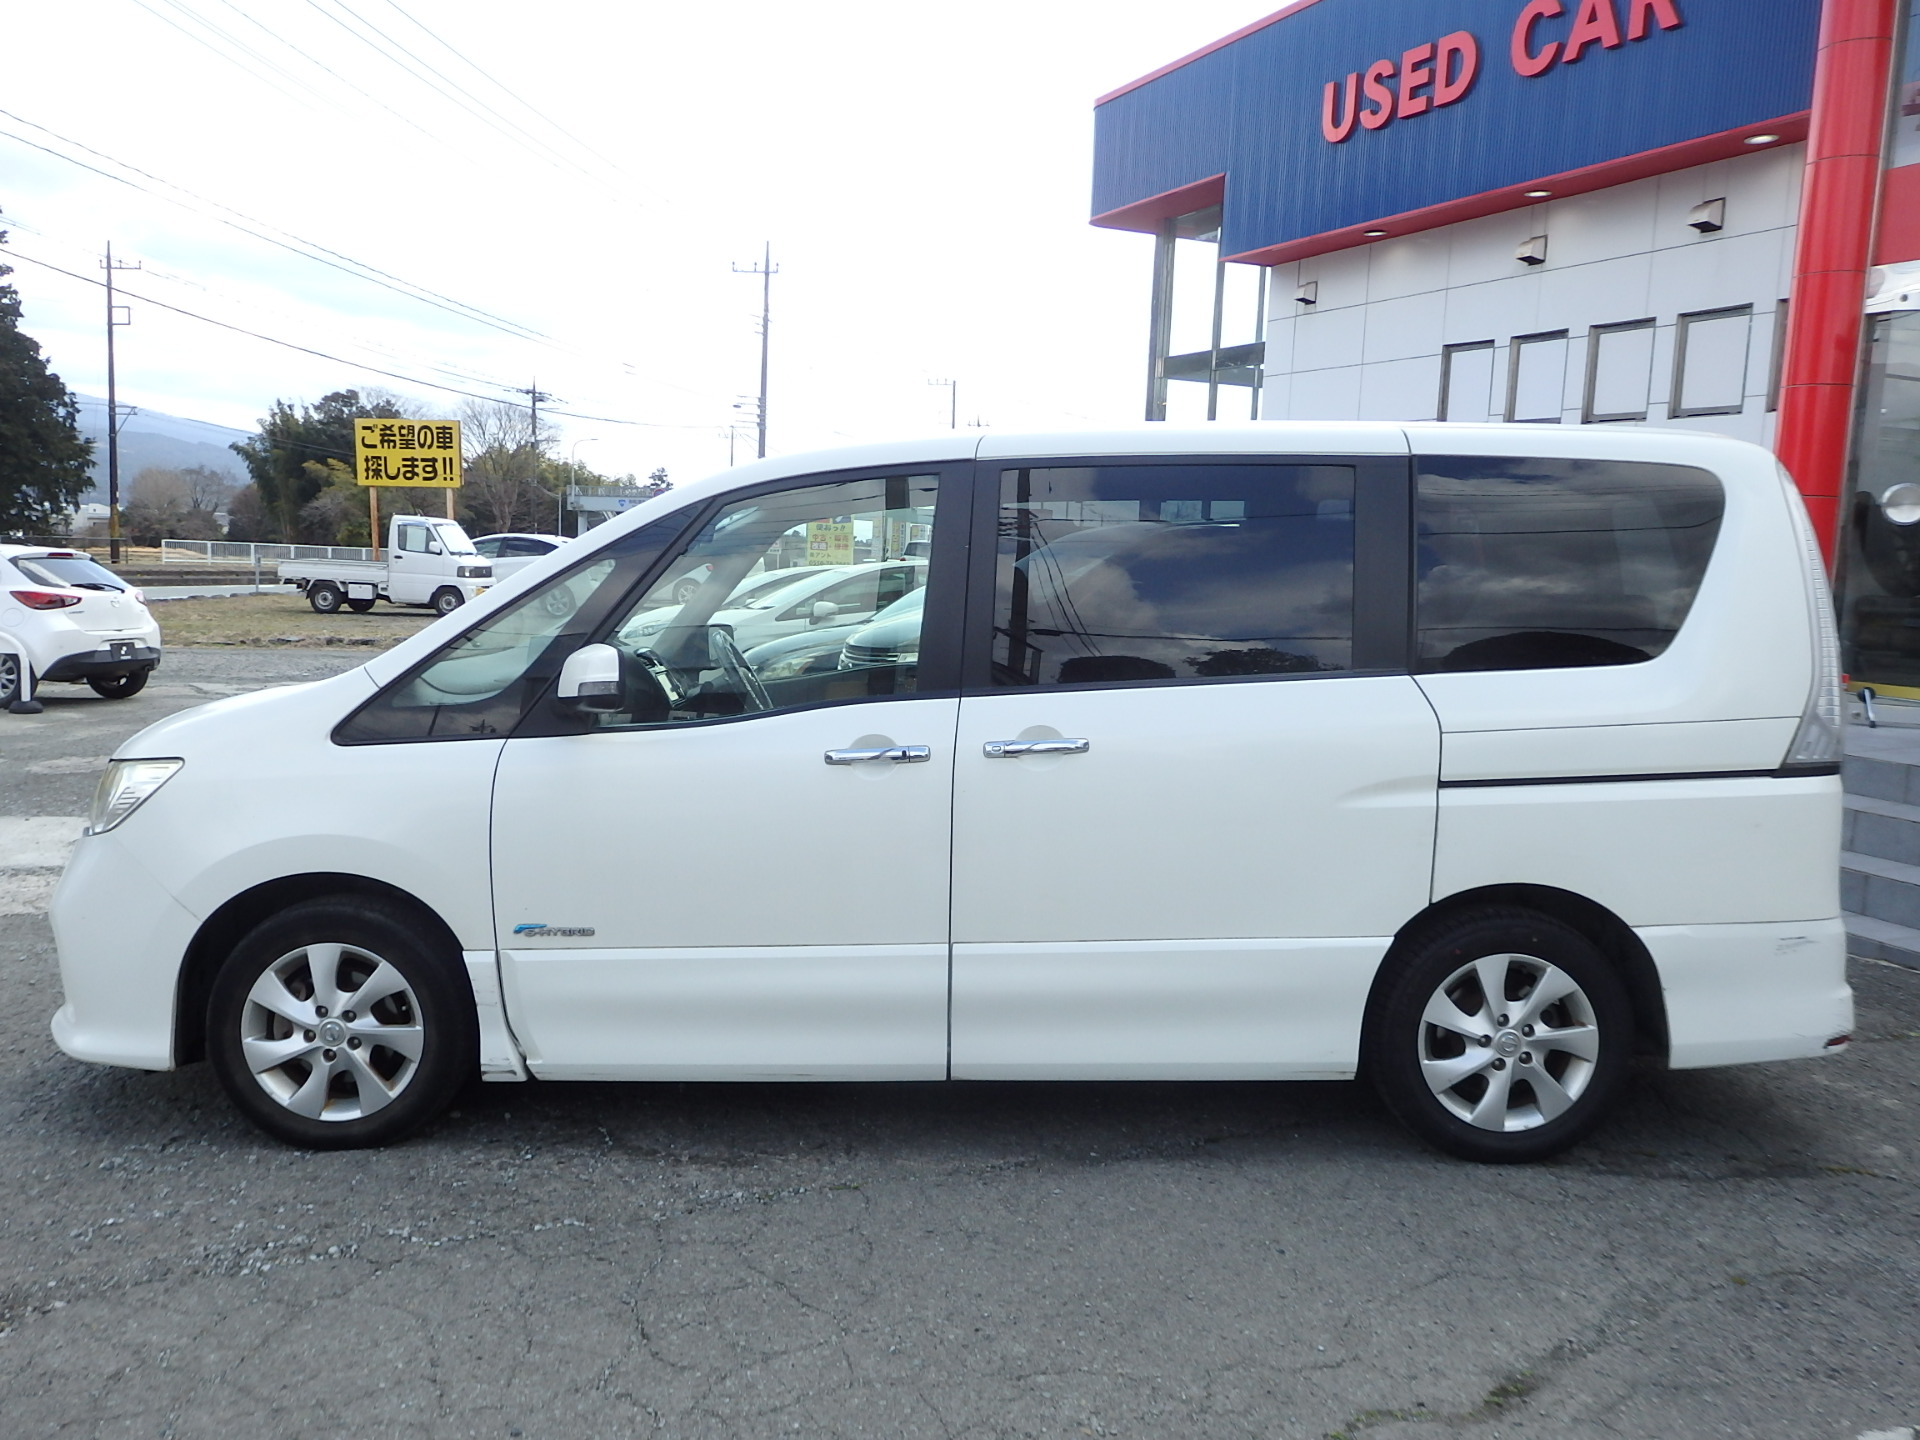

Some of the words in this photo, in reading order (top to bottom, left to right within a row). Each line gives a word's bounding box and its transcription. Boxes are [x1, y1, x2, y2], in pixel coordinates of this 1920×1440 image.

[1321, 30, 1479, 143] USED
[360, 423, 454, 450] ご希望の車
[363, 455, 454, 481] 探します!!
